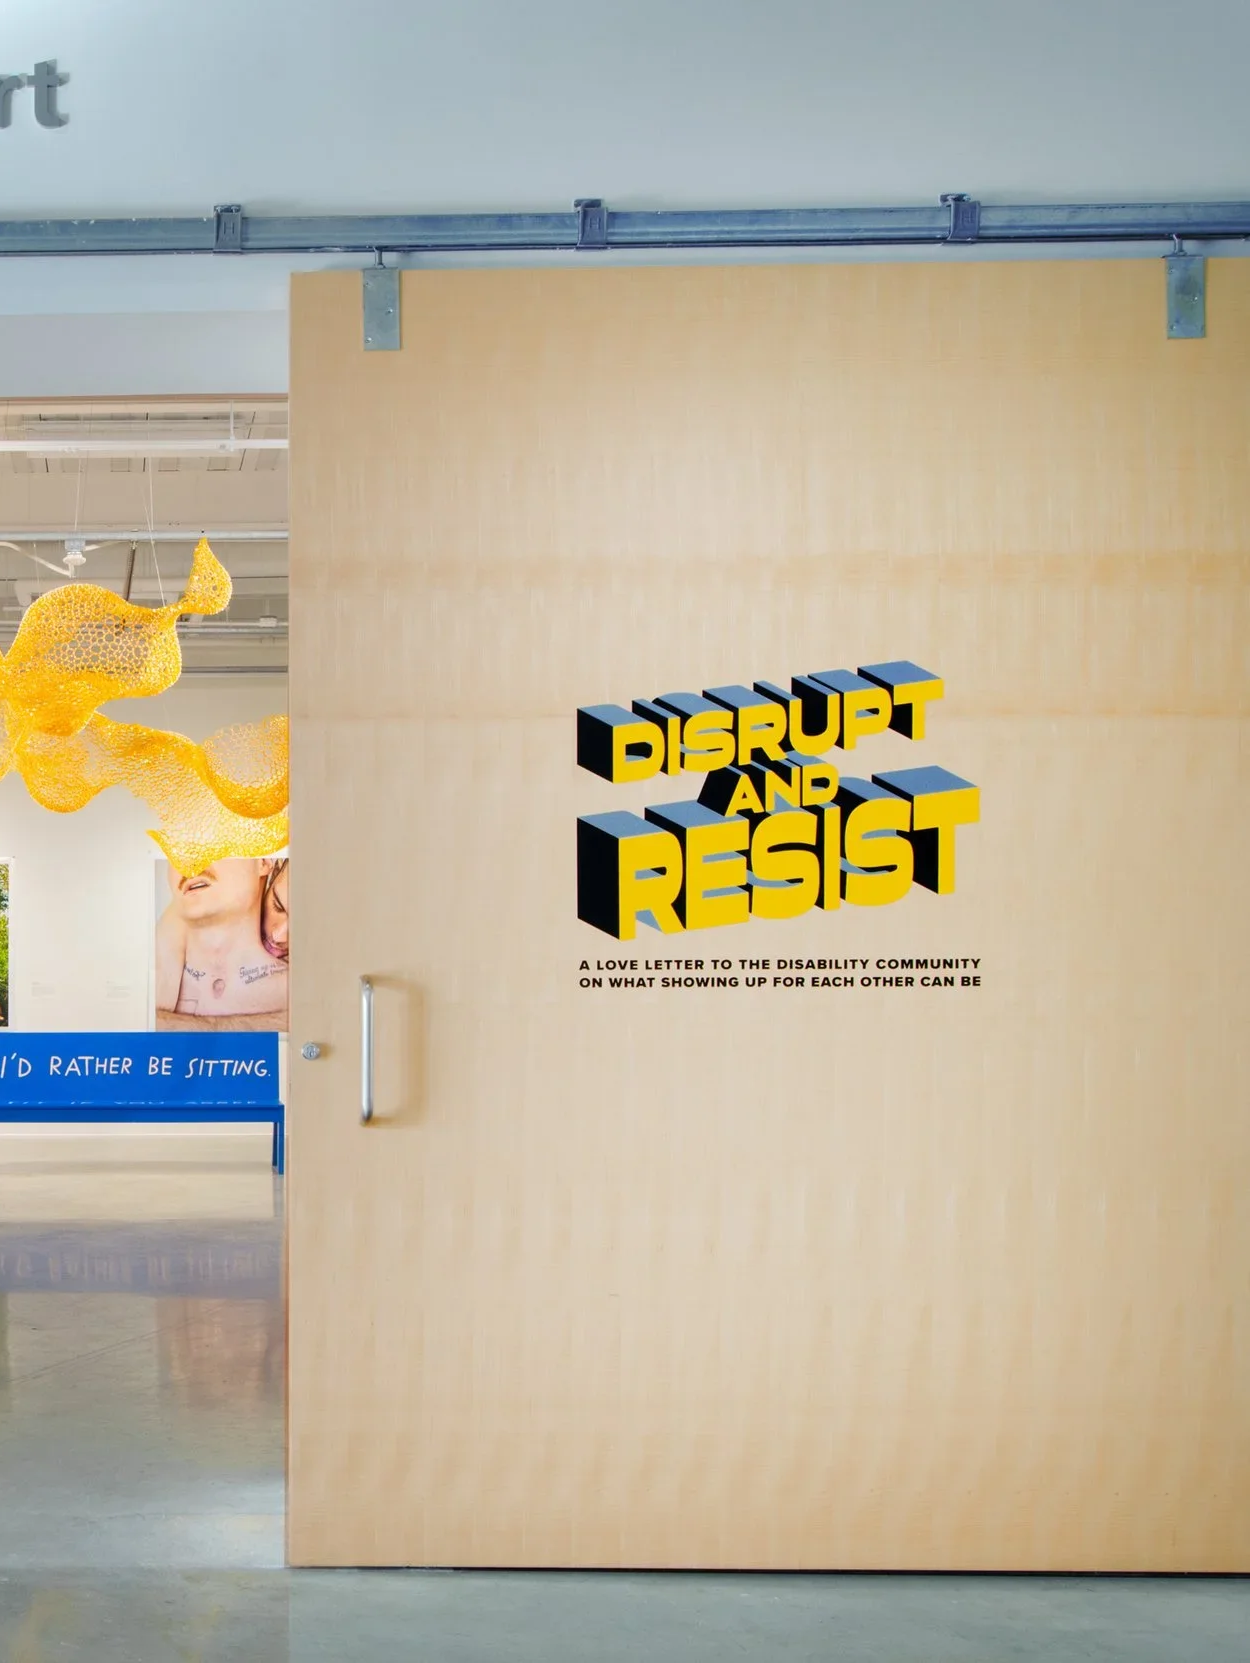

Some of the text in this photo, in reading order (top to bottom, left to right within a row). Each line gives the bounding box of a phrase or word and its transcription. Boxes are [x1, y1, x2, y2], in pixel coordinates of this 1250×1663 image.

[579, 661, 944, 784] DISRUPT
[708, 757, 840, 817] AND
[578, 766, 980, 941] RESIST
[578, 958, 982, 971] A LOVE LETTER TO THE DISABILITY COMMUNITY
[579, 976, 982, 988] ON WHAT SHOWING UP FOR EACH OTHER CAN BE
[0, 1052, 272, 1079] I'D RATHER BE SITTING.
